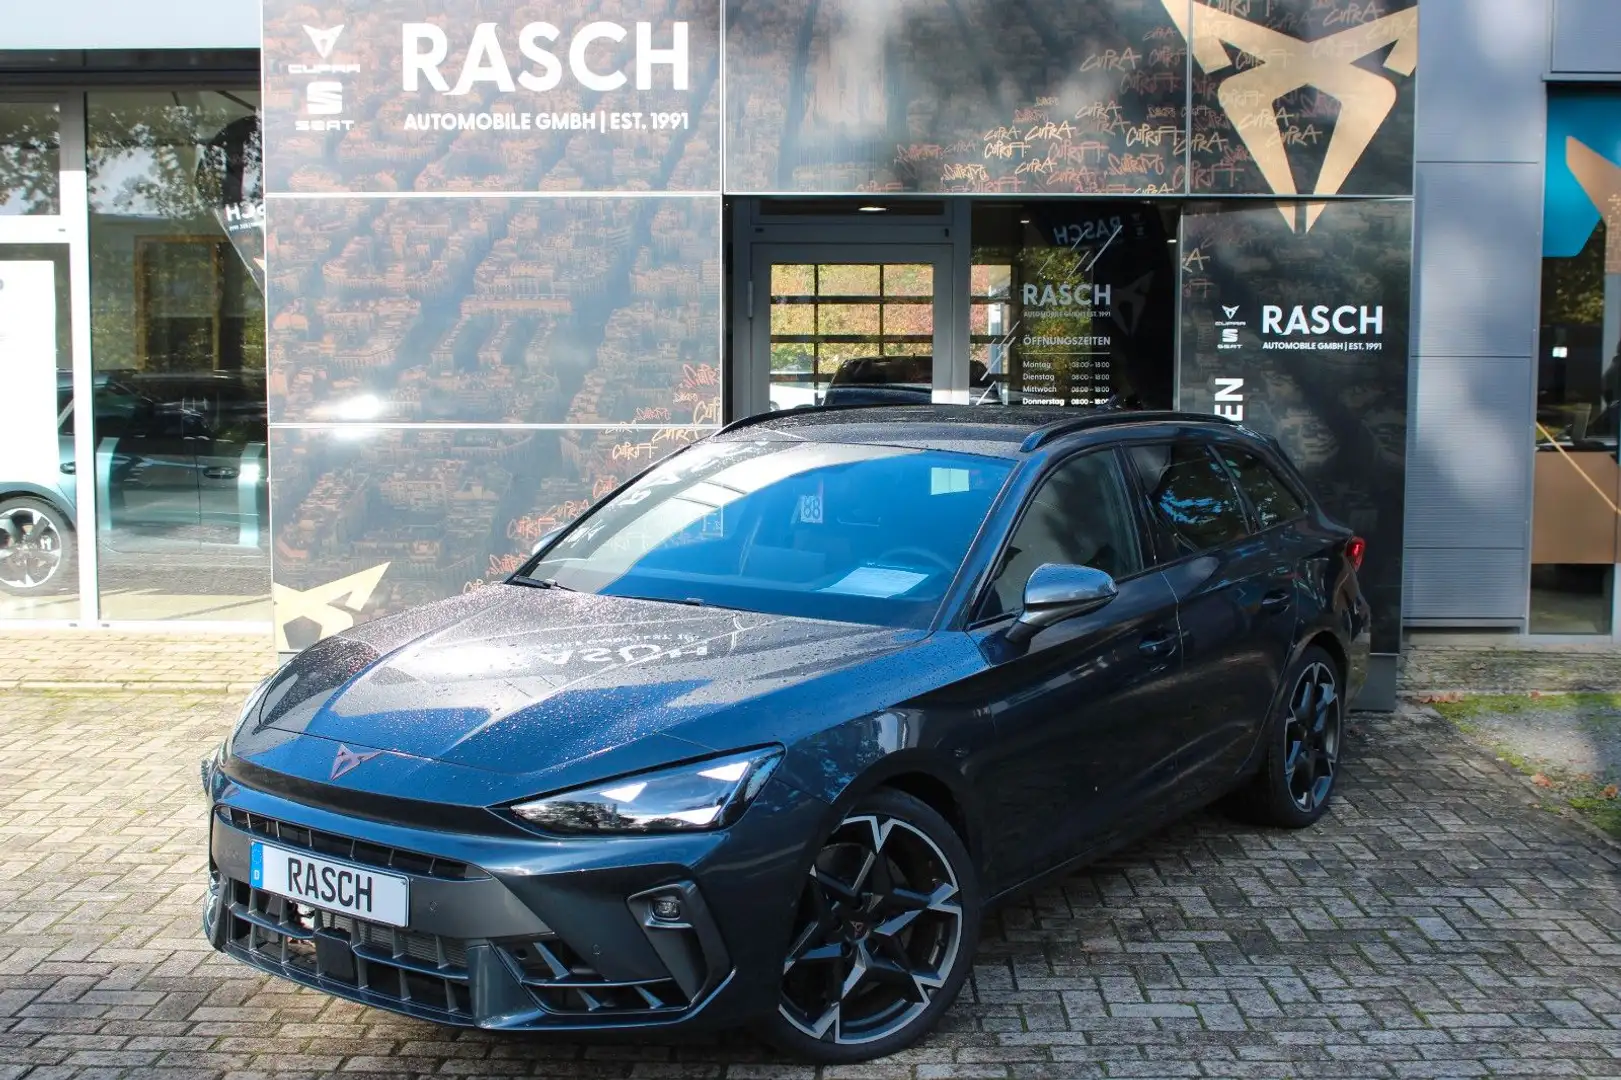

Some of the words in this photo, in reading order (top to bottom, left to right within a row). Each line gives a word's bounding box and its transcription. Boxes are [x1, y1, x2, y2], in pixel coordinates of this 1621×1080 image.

[402, 21, 689, 95] RASCH
[294, 119, 355, 131] SEAT
[403, 112, 531, 131] AUTOMOBILE
[535, 112, 598, 131] GMBH
[610, 112, 646, 130] EST.
[650, 112, 689, 130] 1991
[1023, 283, 1111, 306] RASCH
[1262, 305, 1383, 335] RASCH
[1023, 335, 1111, 346] ÖFFNUNGSZEITEN
[1262, 342, 1316, 350] AUTOMOBILE
[1317, 342, 1343, 350] GMBH
[1349, 342, 1364, 350] EST.
[1365, 342, 1382, 350] 1991
[1022, 361, 1051, 370] Montag
[1022, 373, 1055, 382] Dienstag
[1022, 385, 1057, 393] Mittwoch
[1022, 397, 1065, 406] Donnerstag
[287, 857, 373, 913] RASCH
